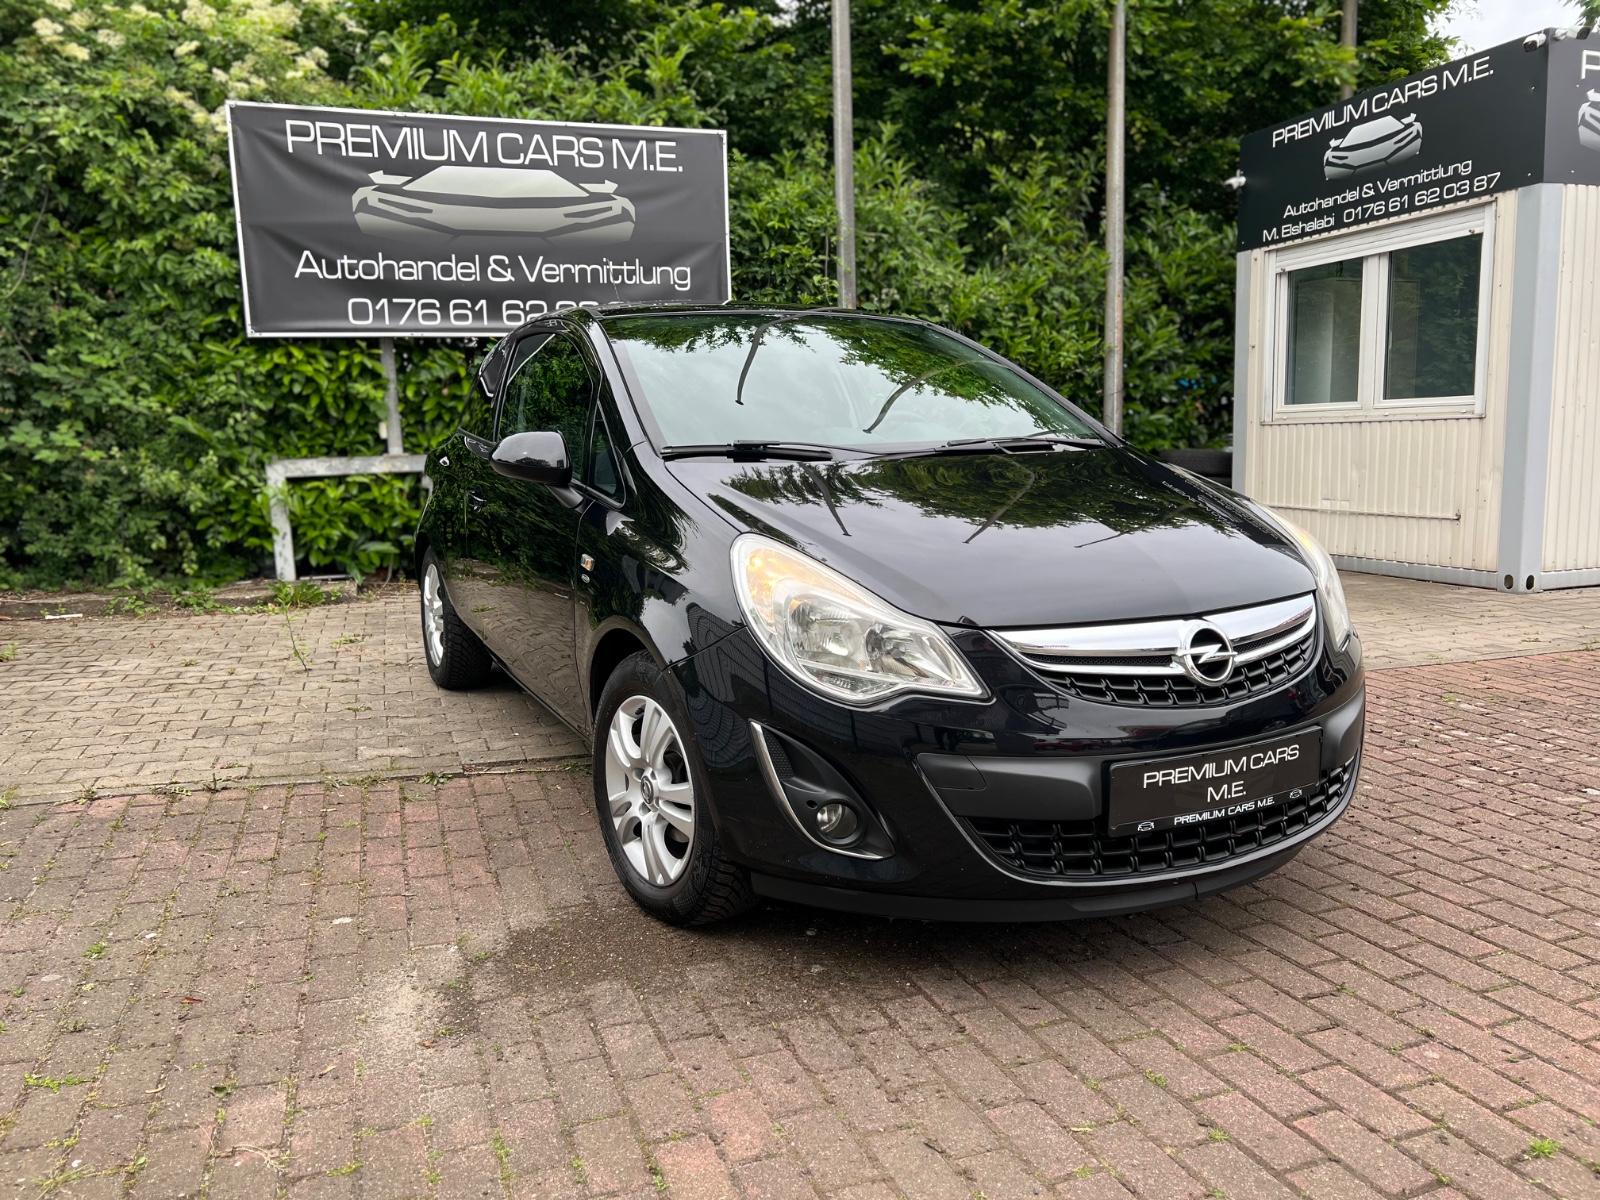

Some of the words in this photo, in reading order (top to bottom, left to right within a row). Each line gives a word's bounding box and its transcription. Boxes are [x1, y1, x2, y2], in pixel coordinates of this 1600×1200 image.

[1272, 98, 1368, 148] PREMIUM
[1372, 75, 1438, 113] CARS
[1442, 56, 1494, 91] M.E.
[285, 119, 490, 164] PREMIUM
[496, 131, 604, 169] CARS
[612, 137, 683, 173] M.E.
[1263, 227, 1279, 242] M.
[1343, 201, 1386, 223] 0176
[1388, 194, 1409, 212] 61
[1414, 187, 1440, 206] 62
[1443, 180, 1470, 199] 03
[1473, 172, 1501, 192] 87
[1283, 186, 1359, 219] Autohandel
[1362, 182, 1376, 198] &
[1376, 160, 1472, 193] Vermittlung
[294, 250, 480, 283] Autohandel
[487, 254, 515, 283] &
[518, 255, 691, 291] Vermittlung
[347, 298, 441, 326] 0176
[449, 299, 488, 326] 61
[1143, 757, 1247, 789] PREMIUM
[1250, 744, 1300, 770] CARS
[1174, 808, 1226, 825] PREMIUM
[1228, 801, 1255, 816] CARS
[1257, 797, 1275, 808] M.E.
[1207, 781, 1247, 802] M.E.
